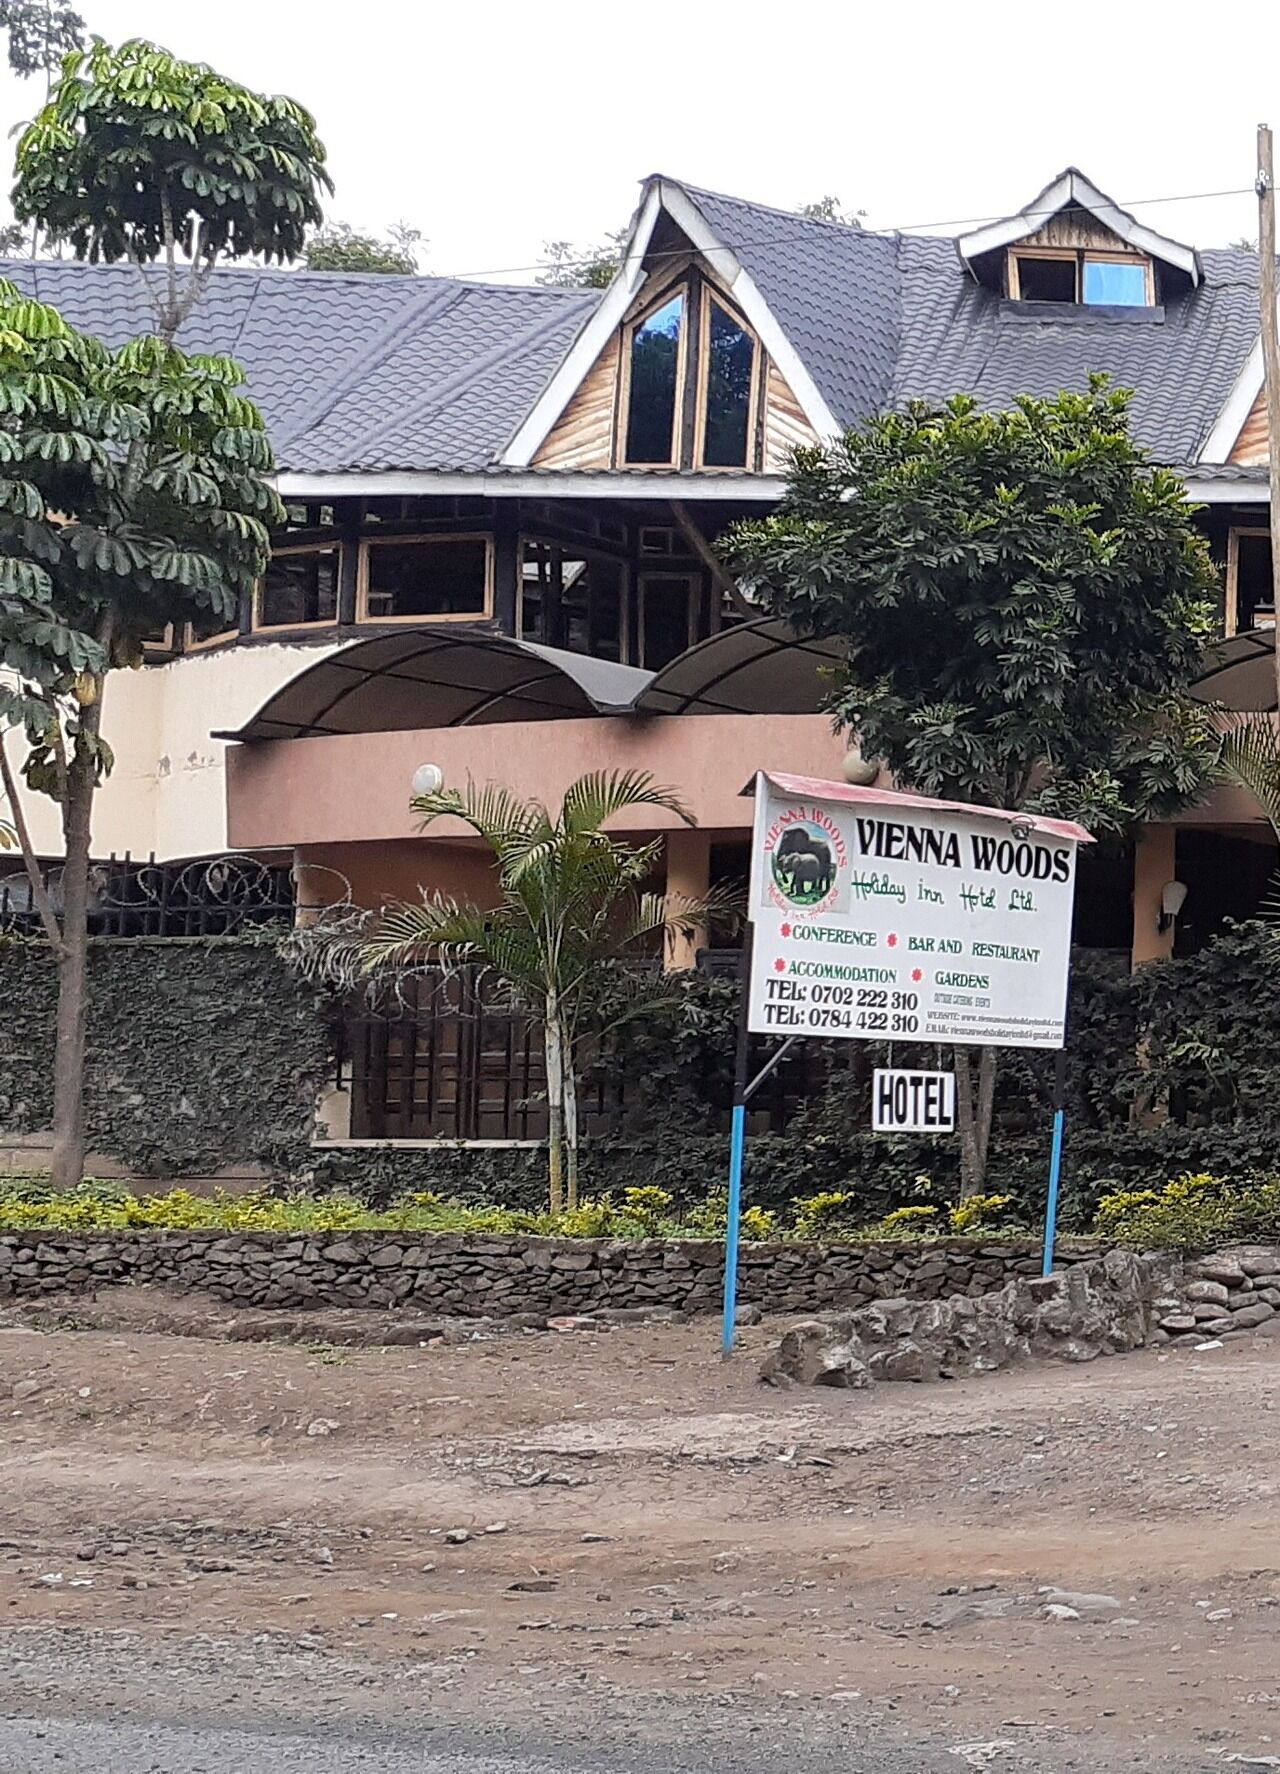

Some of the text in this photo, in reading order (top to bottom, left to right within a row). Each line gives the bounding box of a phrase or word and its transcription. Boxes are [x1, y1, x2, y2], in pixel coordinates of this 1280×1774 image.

[764, 806, 847, 869] VIENNA WOODS
[856, 818, 1070, 883] VIENNA WOODS
[851, 870, 907, 904] Holiday
[960, 883, 997, 913] Hotel
[1008, 889, 1038, 912] Ltd.
[792, 924, 1040, 963] CONFERENCE BAR AND RESTAURANT
[766, 978, 918, 1011] TEL: 0702 222 310
[788, 960, 990, 989] ACCOMMODATION GARDENS
[764, 1003, 919, 1033] TEL: 0784 422 310
[878, 1074, 952, 1126] HOTEL
